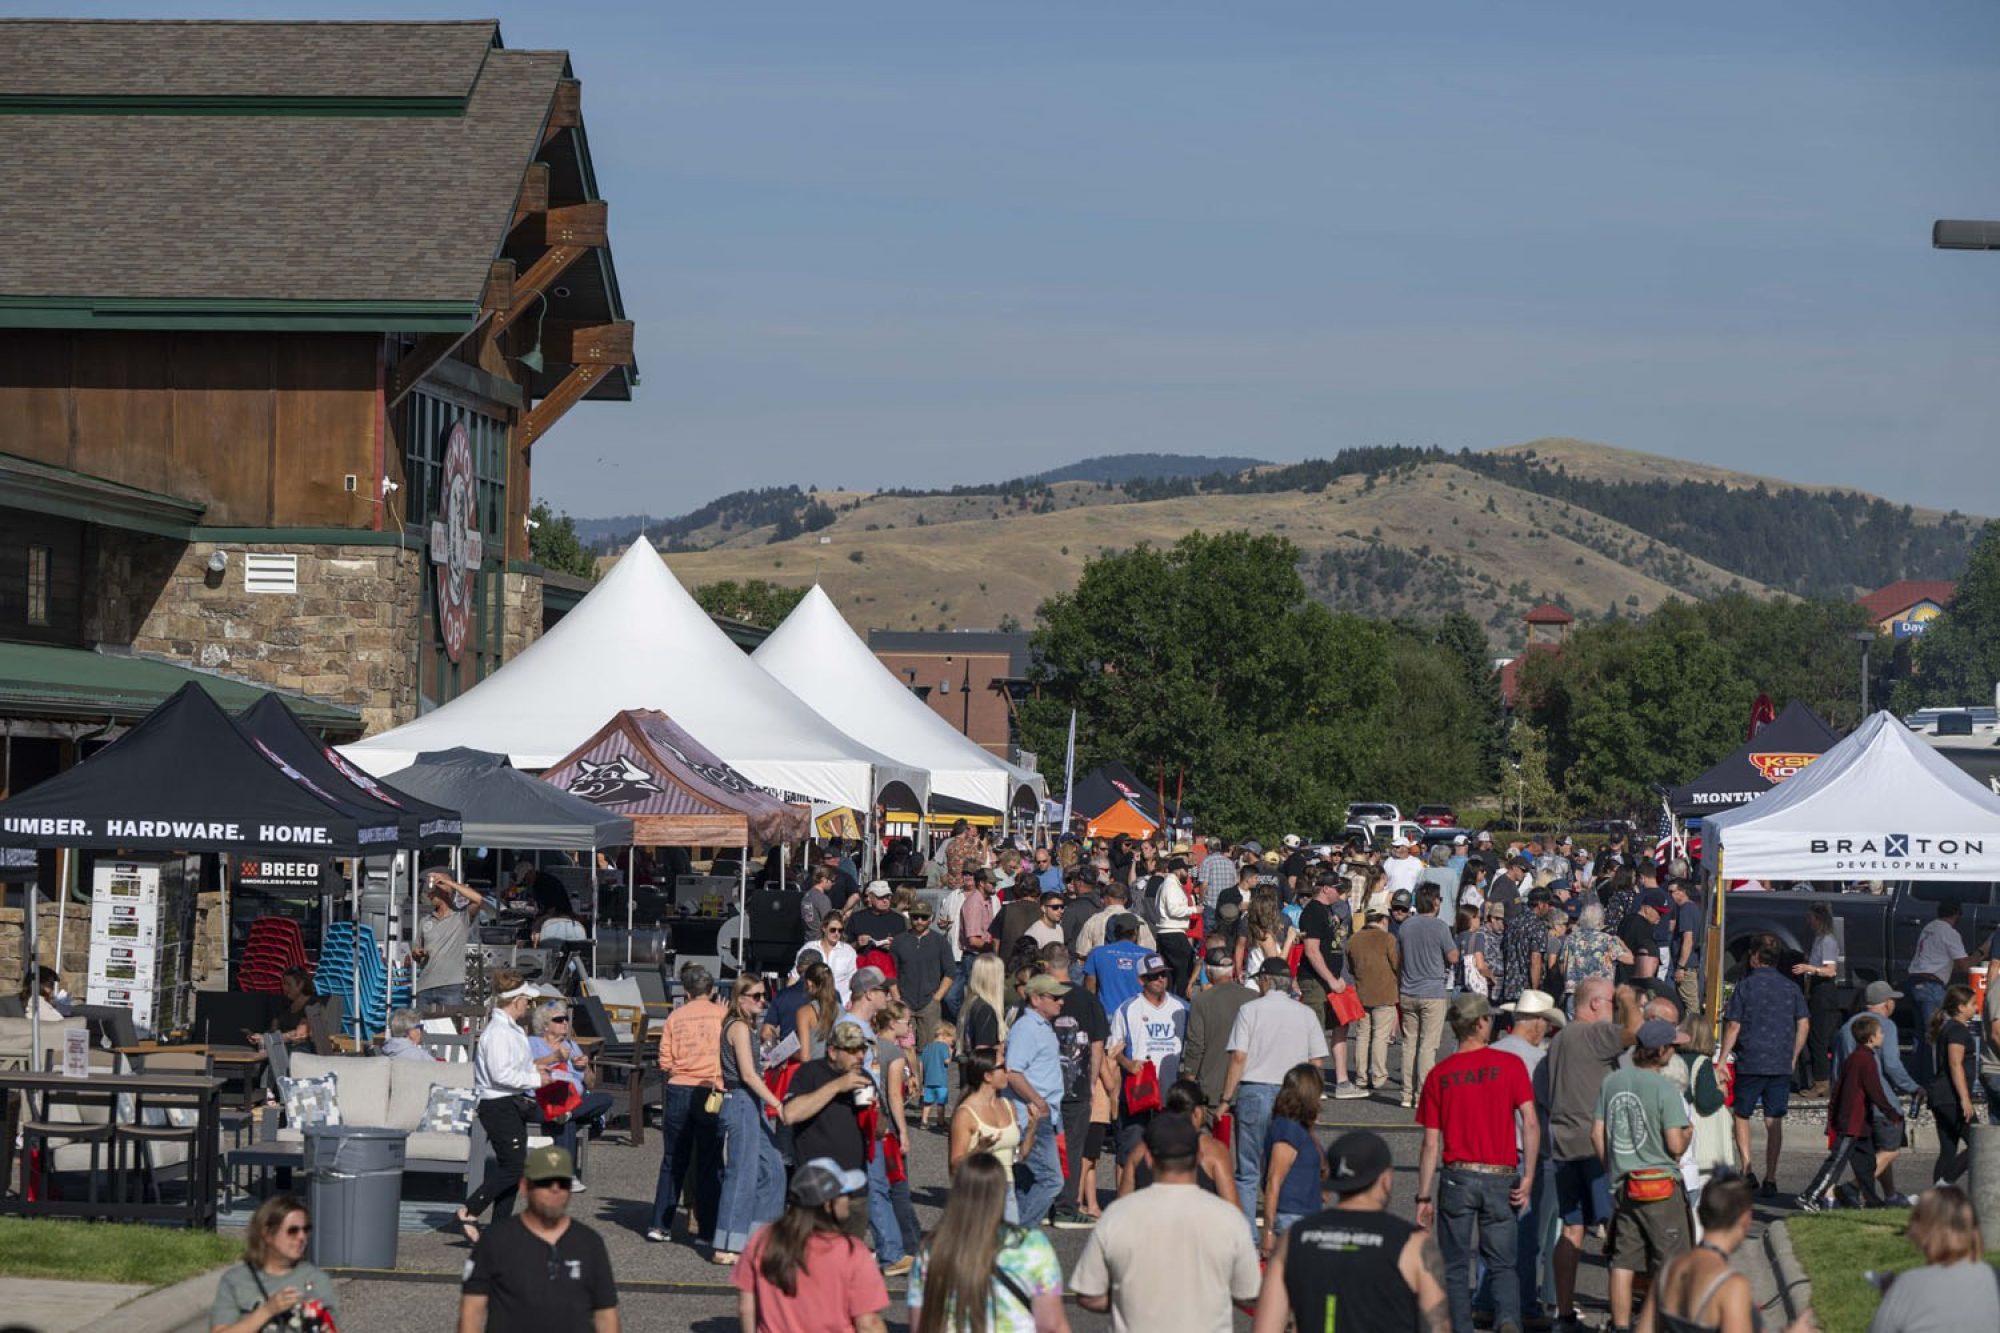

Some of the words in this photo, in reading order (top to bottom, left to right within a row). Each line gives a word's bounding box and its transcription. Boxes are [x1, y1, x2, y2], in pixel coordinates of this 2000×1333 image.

[1772, 767, 1803, 777] 10
[107, 820, 245, 841] HARDWARE.
[259, 824, 333, 844] HOME.
[1810, 835, 1983, 856] BRAXTON
[261, 862, 319, 877] BREEO
[1836, 861, 1960, 870] DEVELOPMENT
[1145, 1023, 1170, 1037] VPV
[1439, 1066, 1500, 1088] STAFF
